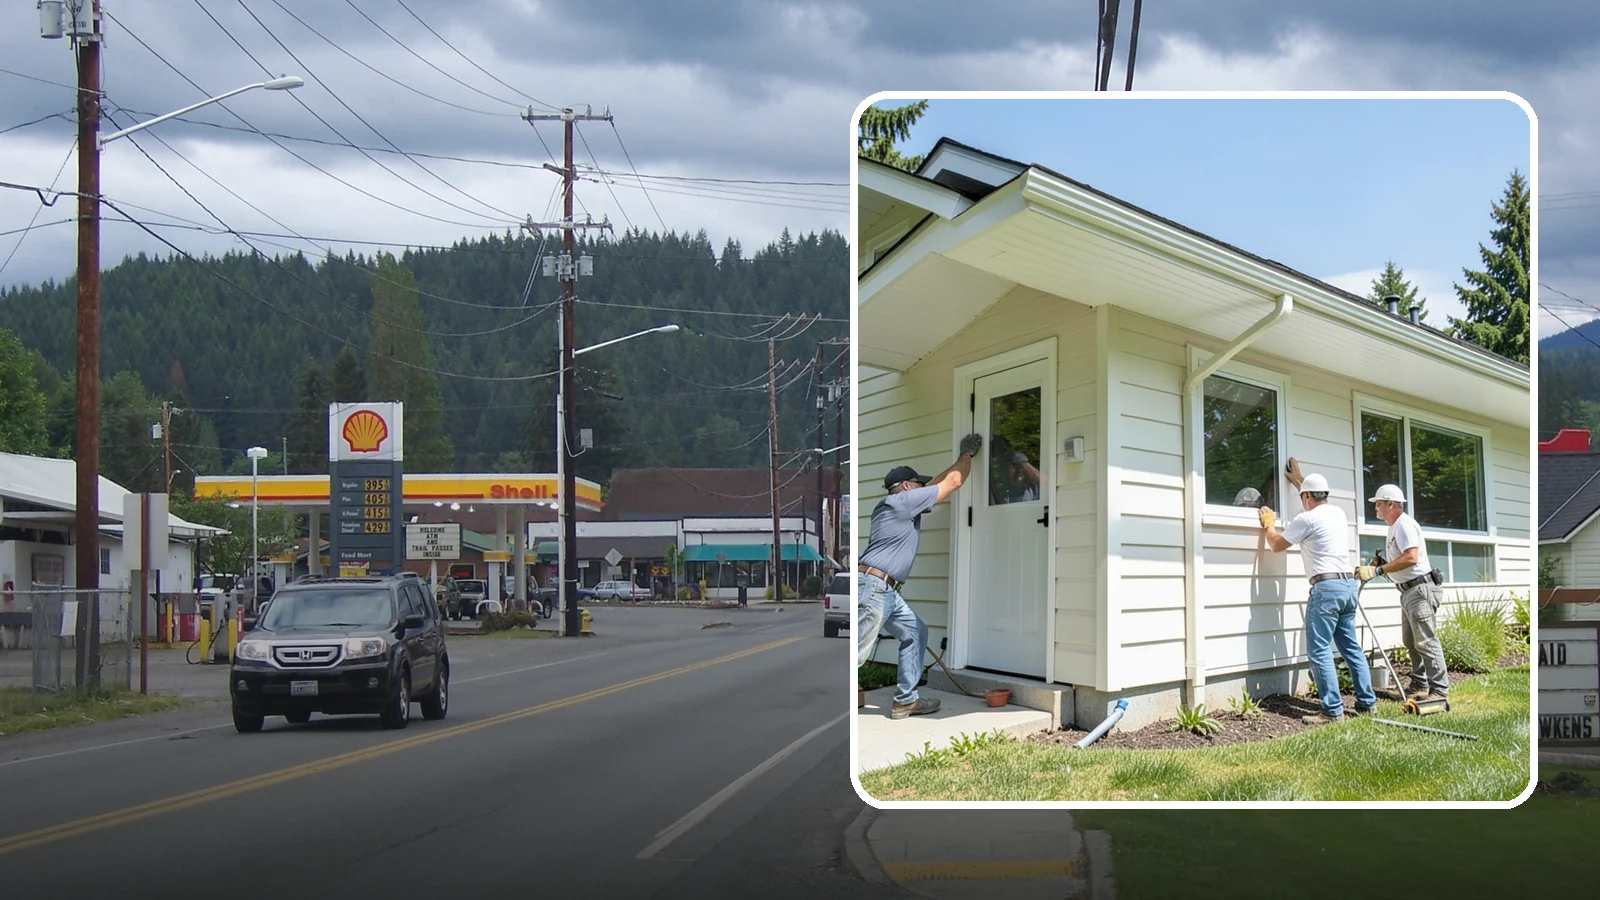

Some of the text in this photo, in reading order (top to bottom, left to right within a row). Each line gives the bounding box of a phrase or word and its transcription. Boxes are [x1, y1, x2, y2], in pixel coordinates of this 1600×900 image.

[365, 479, 383, 490] 395
[490, 484, 547, 499] Shell
[365, 494, 383, 504] 405
[365, 508, 383, 518] 415
[365, 522, 383, 533] 429
[1538, 642, 1567, 665] AID
[1538, 715, 1592, 738] WKENS
